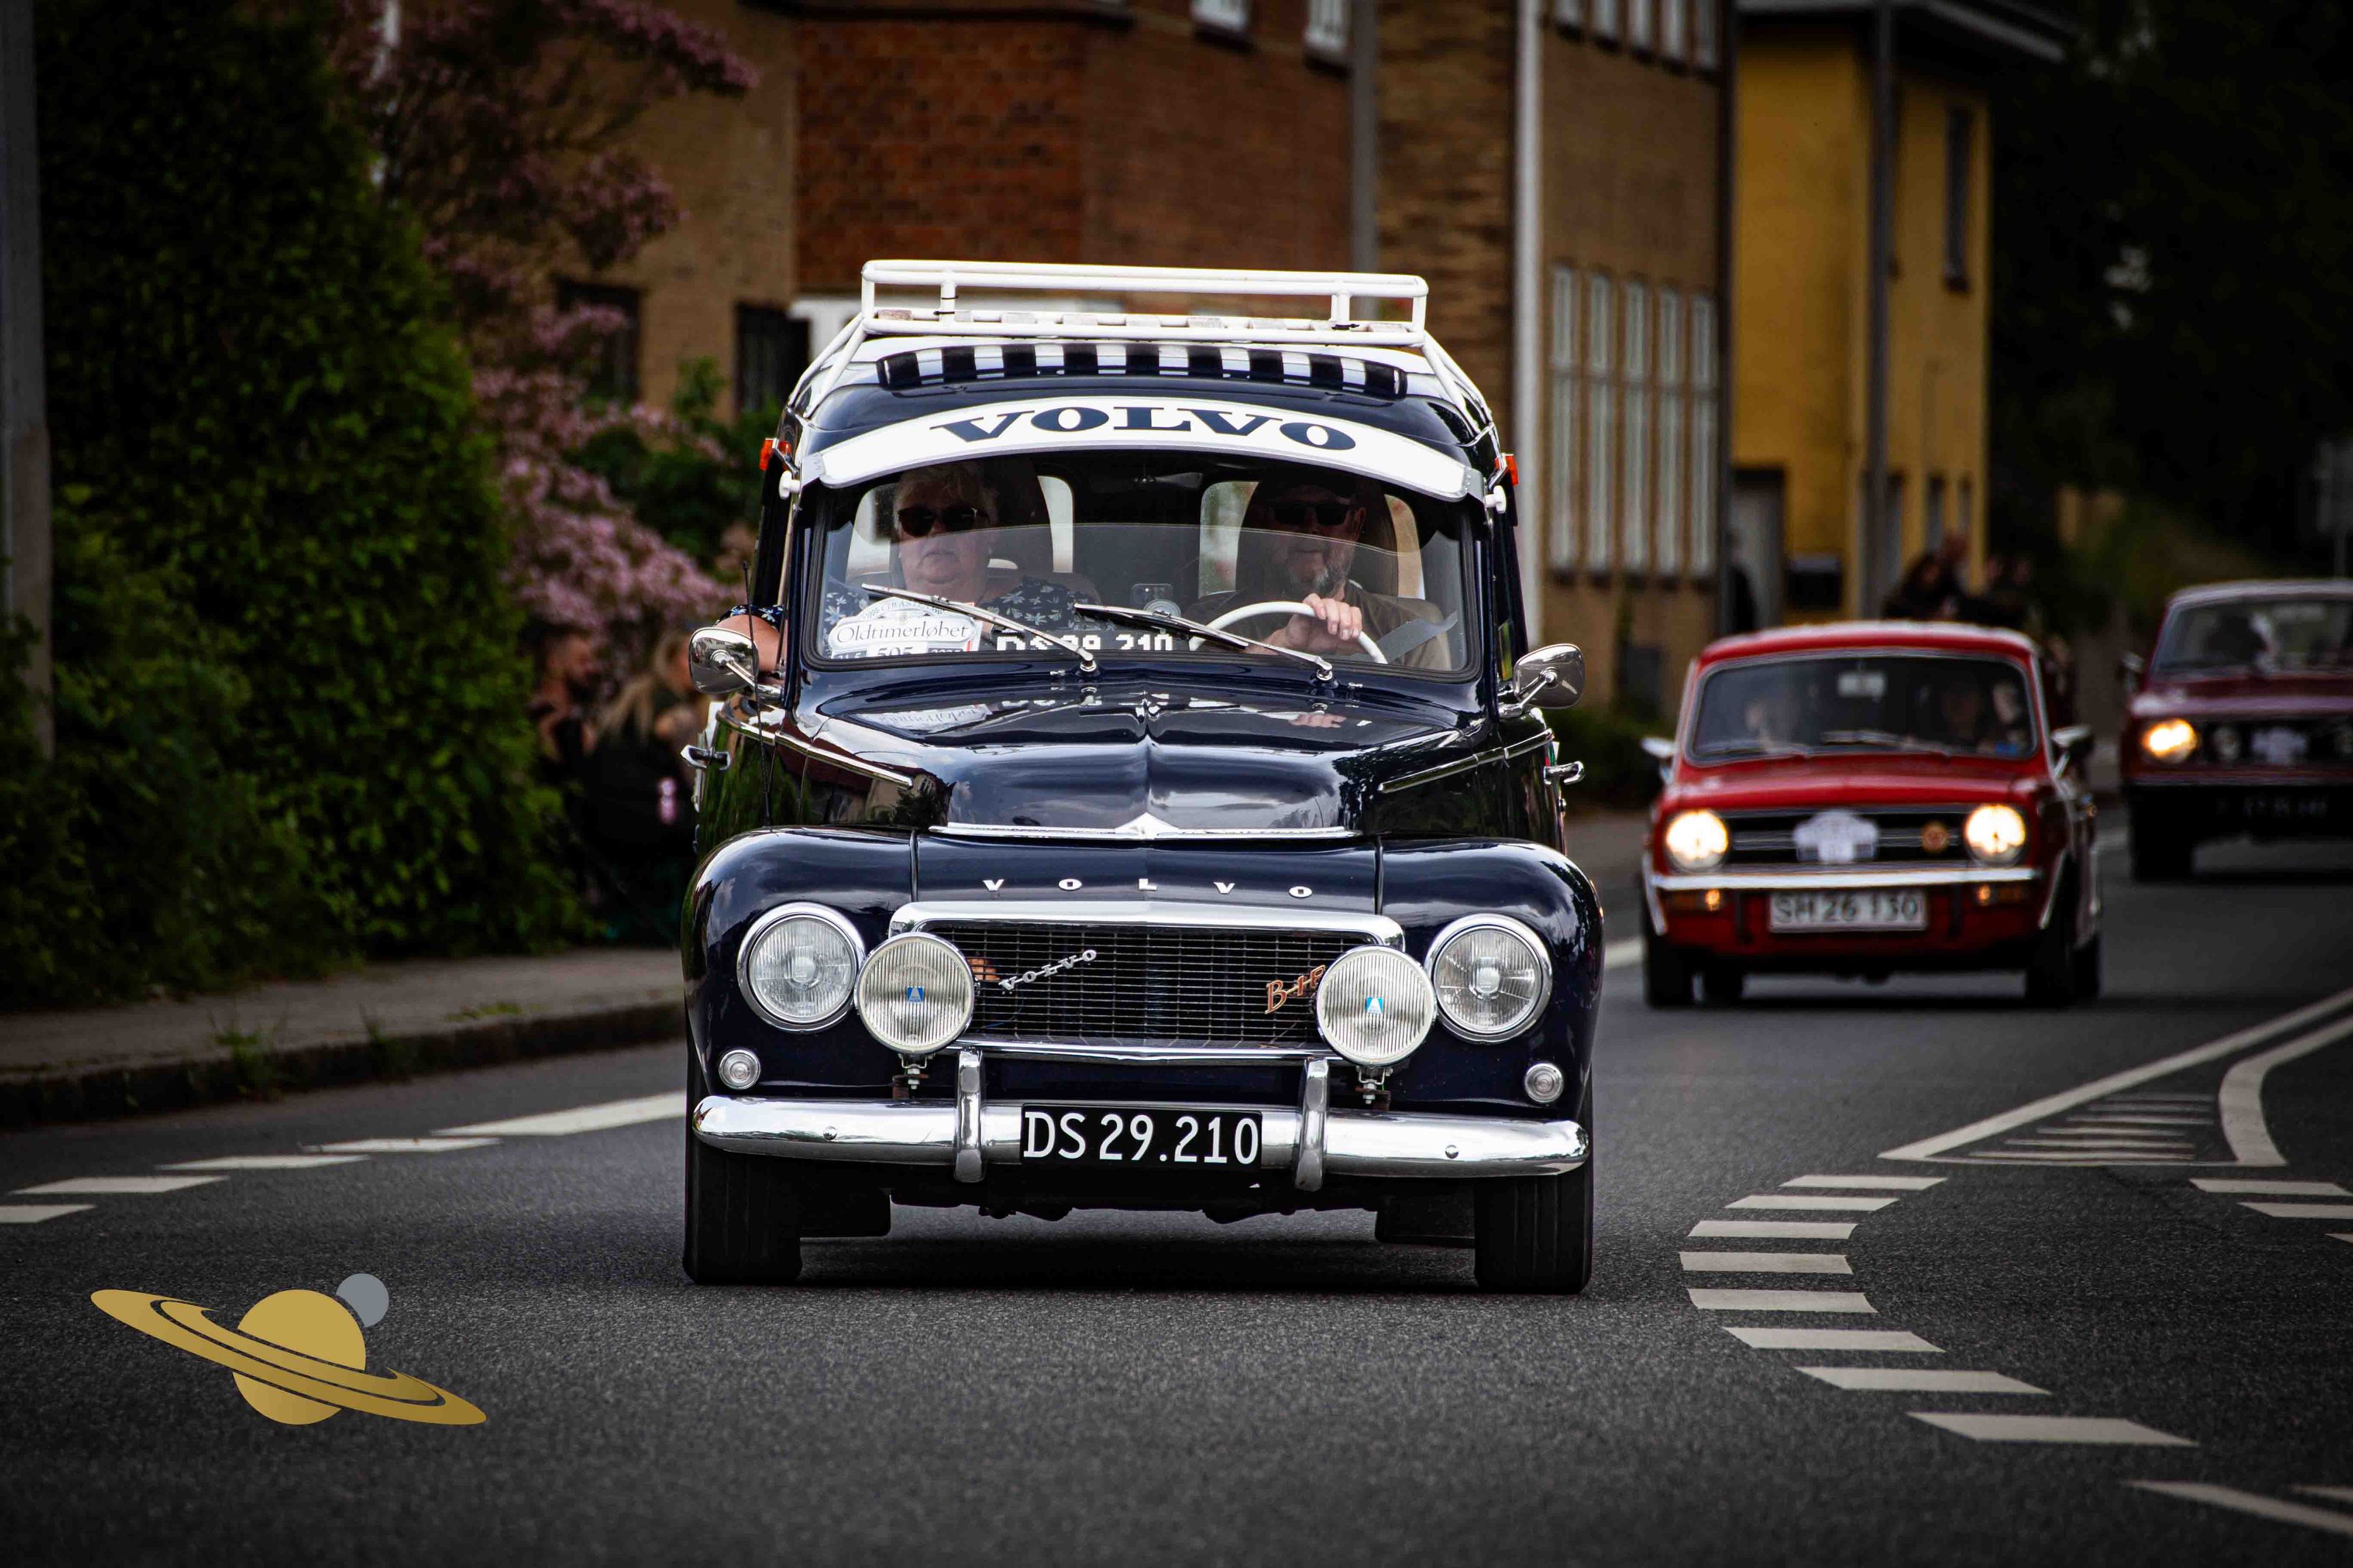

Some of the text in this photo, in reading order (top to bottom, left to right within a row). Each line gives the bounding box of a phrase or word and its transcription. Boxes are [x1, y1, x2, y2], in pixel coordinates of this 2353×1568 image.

[929, 407, 1356, 451] VOLVO
[837, 620, 969, 642] Oldtimerløbet
[982, 878, 1313, 898] VOLVO
[999, 949, 1097, 993] VOLVO
[1023, 1111, 1087, 1159] DS
